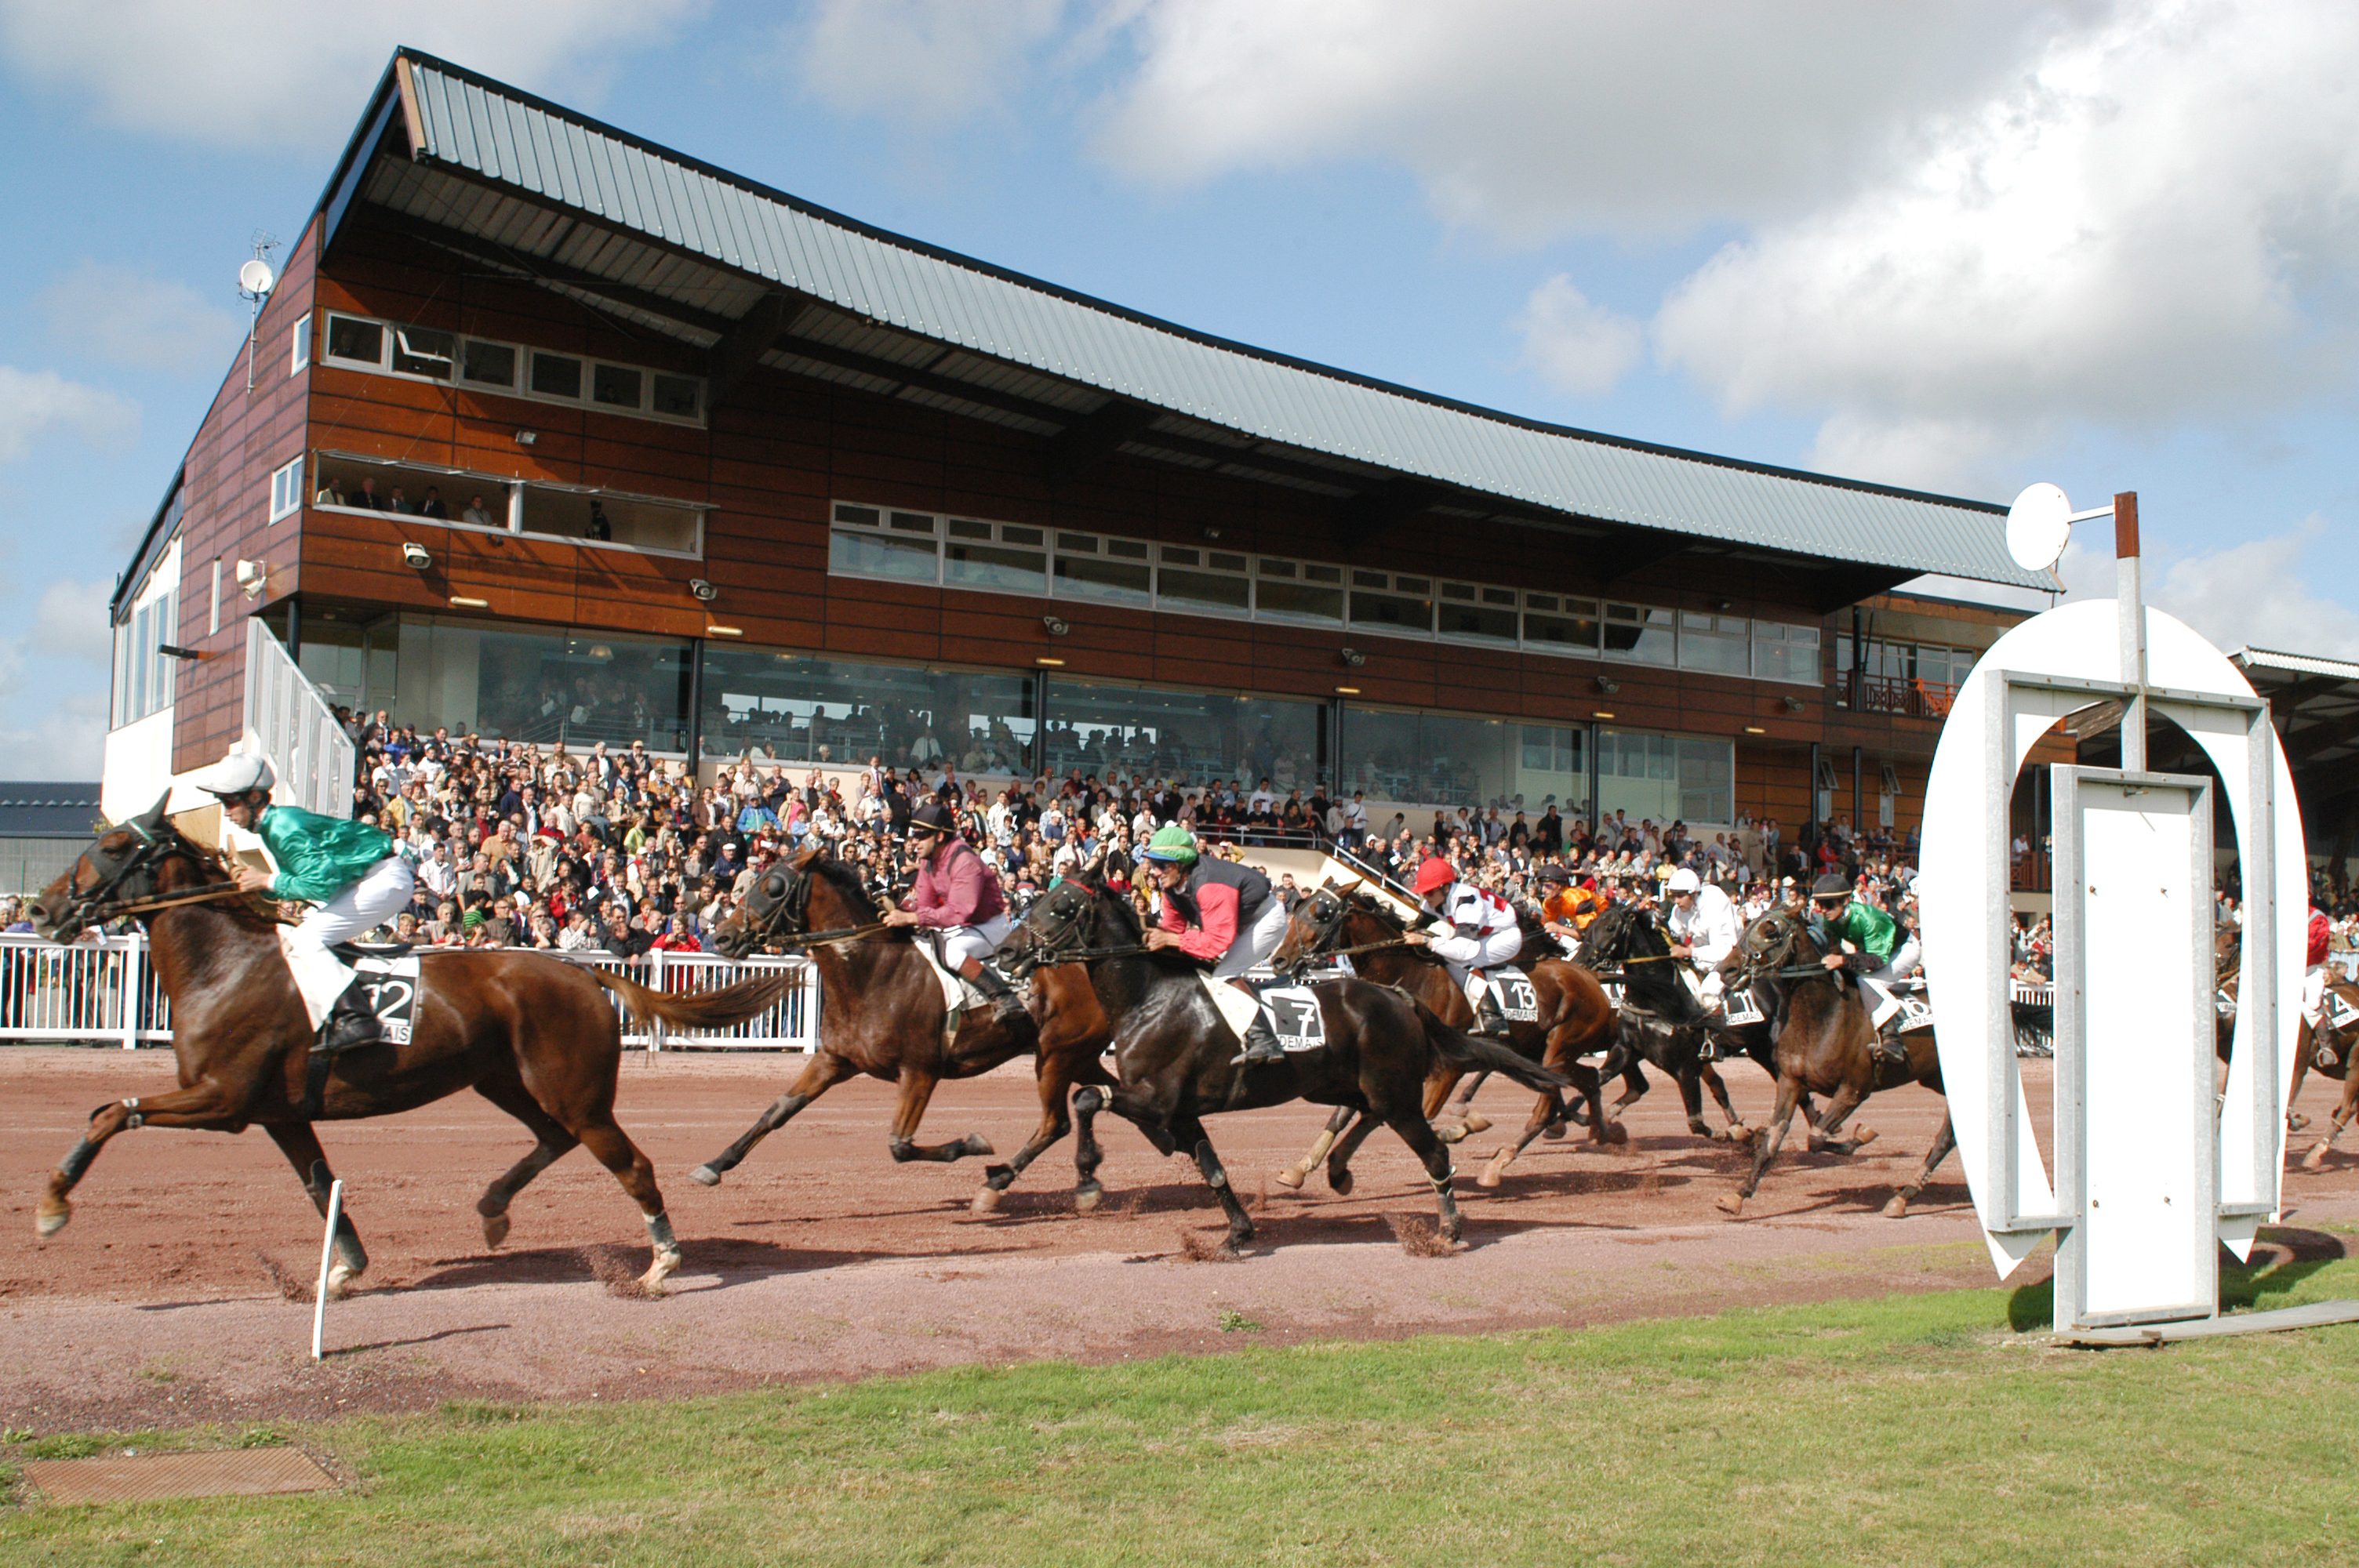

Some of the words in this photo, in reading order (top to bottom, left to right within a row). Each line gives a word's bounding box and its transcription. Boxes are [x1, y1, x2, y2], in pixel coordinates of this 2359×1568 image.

[362, 981, 413, 1025] 12
[1510, 982, 1536, 1010] 13
[1733, 988, 1757, 1013] 11
[1896, 998, 1930, 1018] 16
[2334, 993, 2354, 1013] 4
[1291, 1003, 1315, 1036] 7
